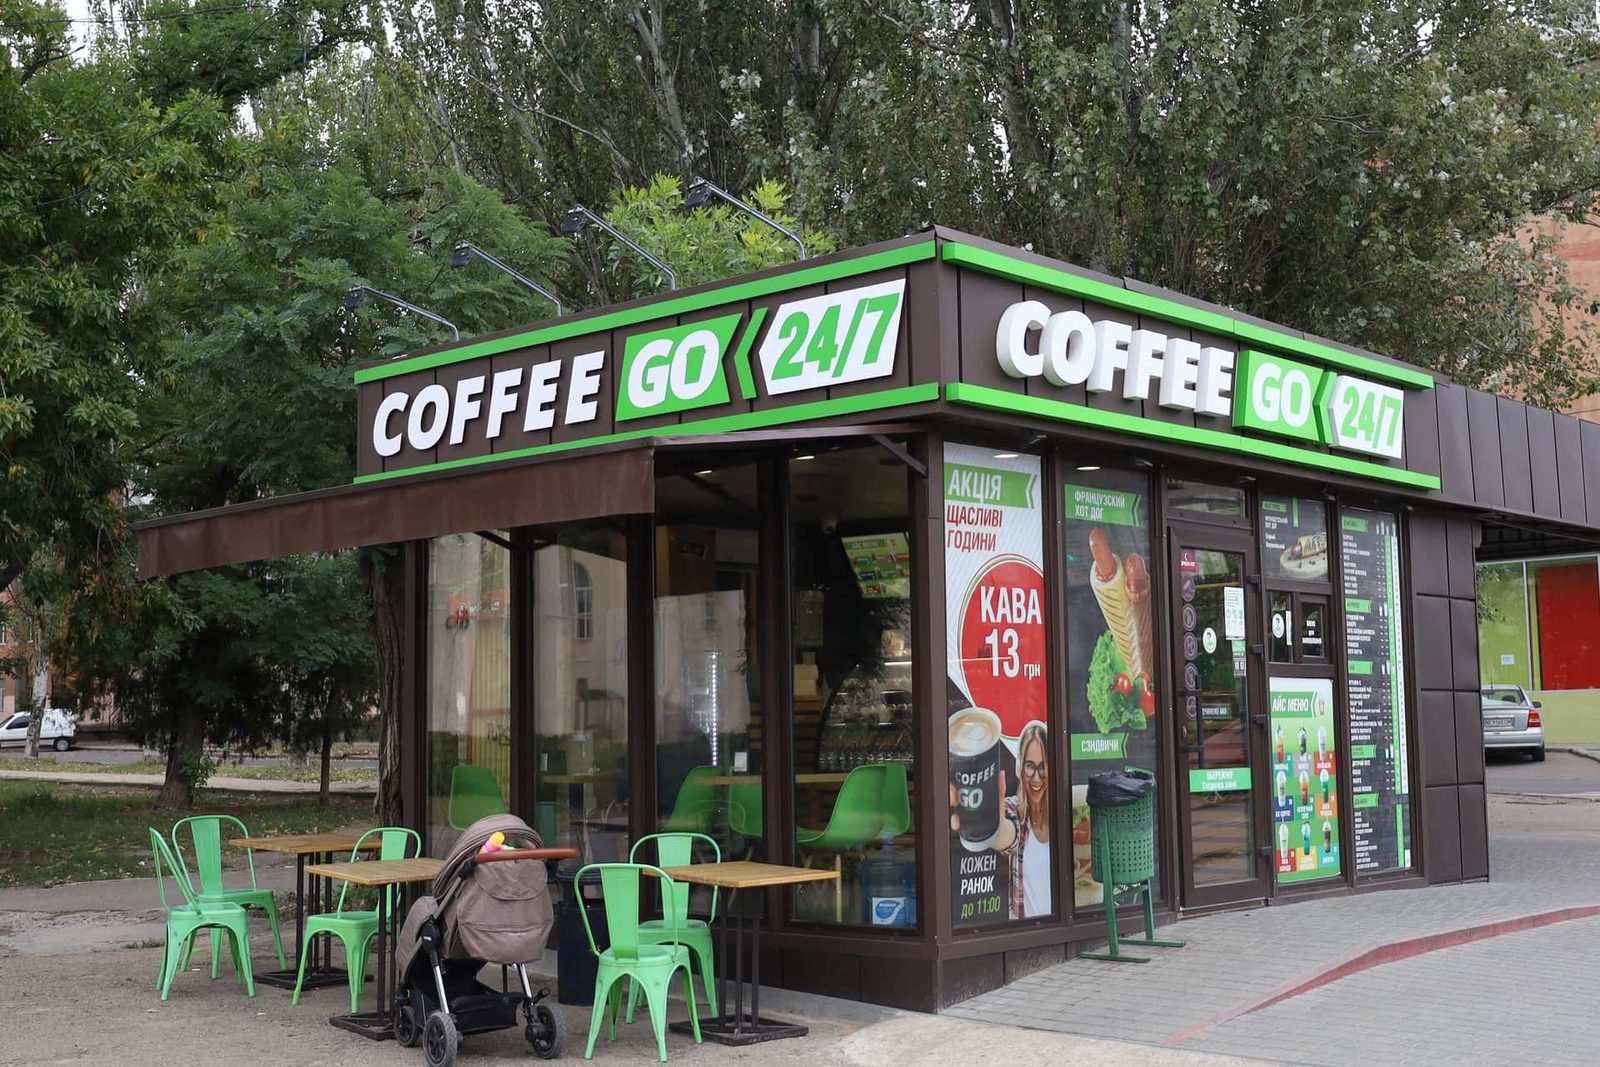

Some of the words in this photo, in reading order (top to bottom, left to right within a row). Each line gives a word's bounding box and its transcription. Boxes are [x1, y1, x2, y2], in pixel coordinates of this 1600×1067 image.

[373, 350, 605, 457] COFFEE
[627, 329, 720, 408] GO
[771, 293, 900, 380] 24/7
[996, 301, 1234, 417] COFFEE
[1251, 362, 1311, 428] GO
[1342, 385, 1401, 449] 24/7
[948, 469, 1002, 504] АКЦІЯ
[1074, 490, 1125, 508] ФРАНЦУЗСКИЙ
[946, 504, 1003, 528] ЩАСЛИВІ
[1074, 503, 1089, 518] ХОТ
[1090, 506, 1104, 521] ДОГ
[947, 529, 997, 553] ГОДИНИ
[980, 585, 1042, 625] КАВА
[985, 628, 1020, 678] 13
[1023, 662, 1041, 681] грн
[1272, 694, 1287, 713] АЙС
[1287, 697, 1309, 713] МЕНЮ
[1081, 739, 1119, 754] СЭНДВИЧИ
[955, 762, 996, 786] COFFEE
[958, 787, 983, 809] GO
[959, 854, 997, 874] КОЖЕН
[960, 875, 995, 895] РАНОК
[976, 895, 1001, 916] 11:00
